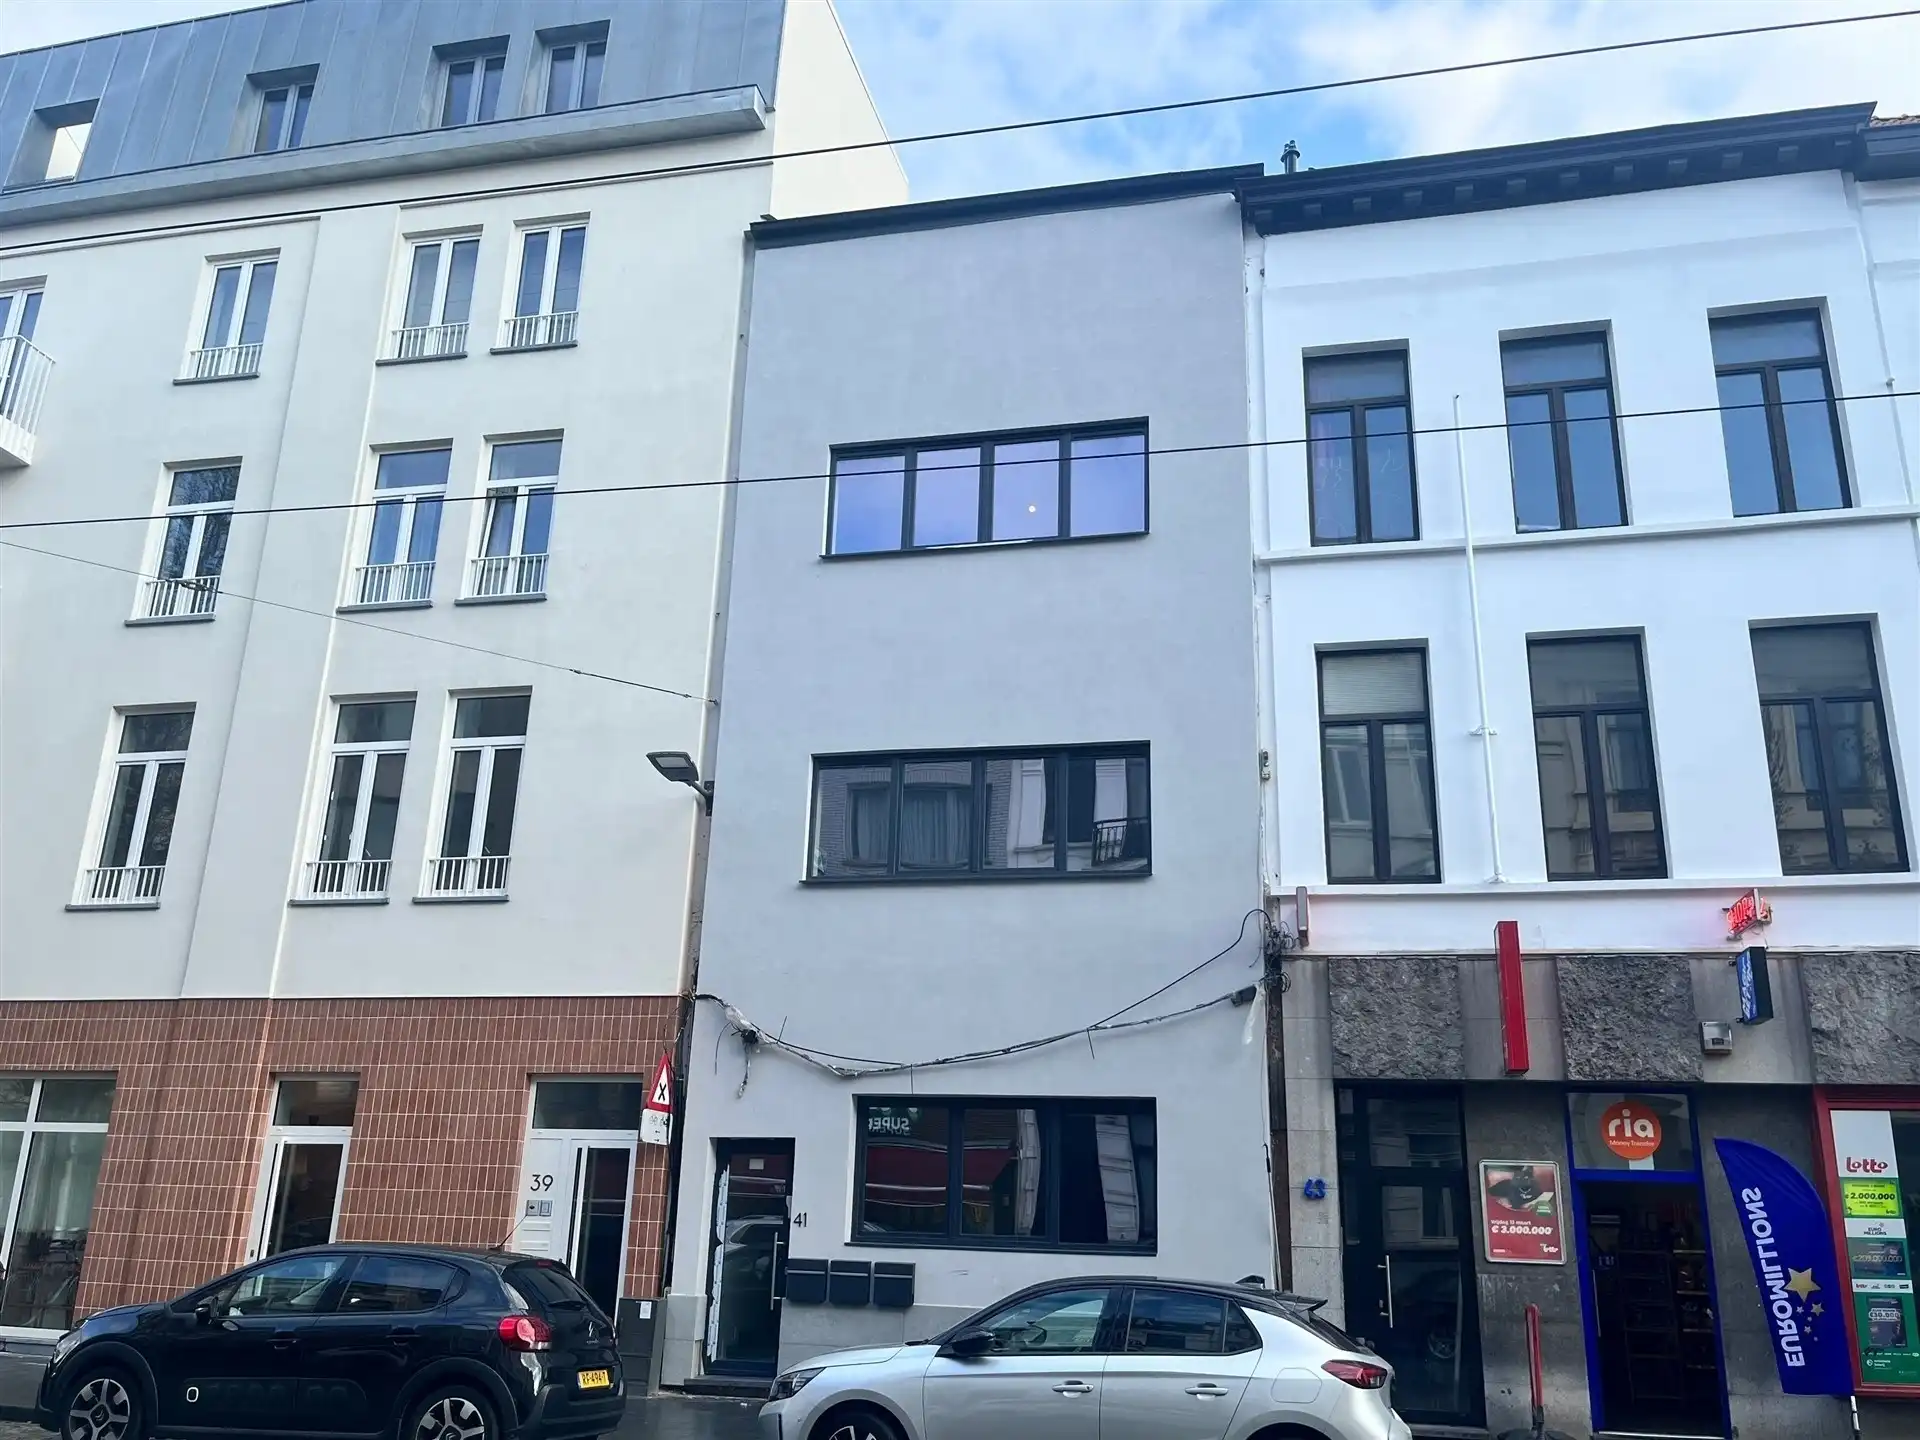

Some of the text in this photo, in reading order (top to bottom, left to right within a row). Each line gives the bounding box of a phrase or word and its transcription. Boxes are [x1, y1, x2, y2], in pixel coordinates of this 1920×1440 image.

[1608, 1108, 1654, 1138] ria
[530, 1174, 554, 1192] 39
[1850, 1192, 1896, 1201] 2.000.000
[793, 1212, 807, 1228] 41
[1491, 1225, 1499, 1233] €
